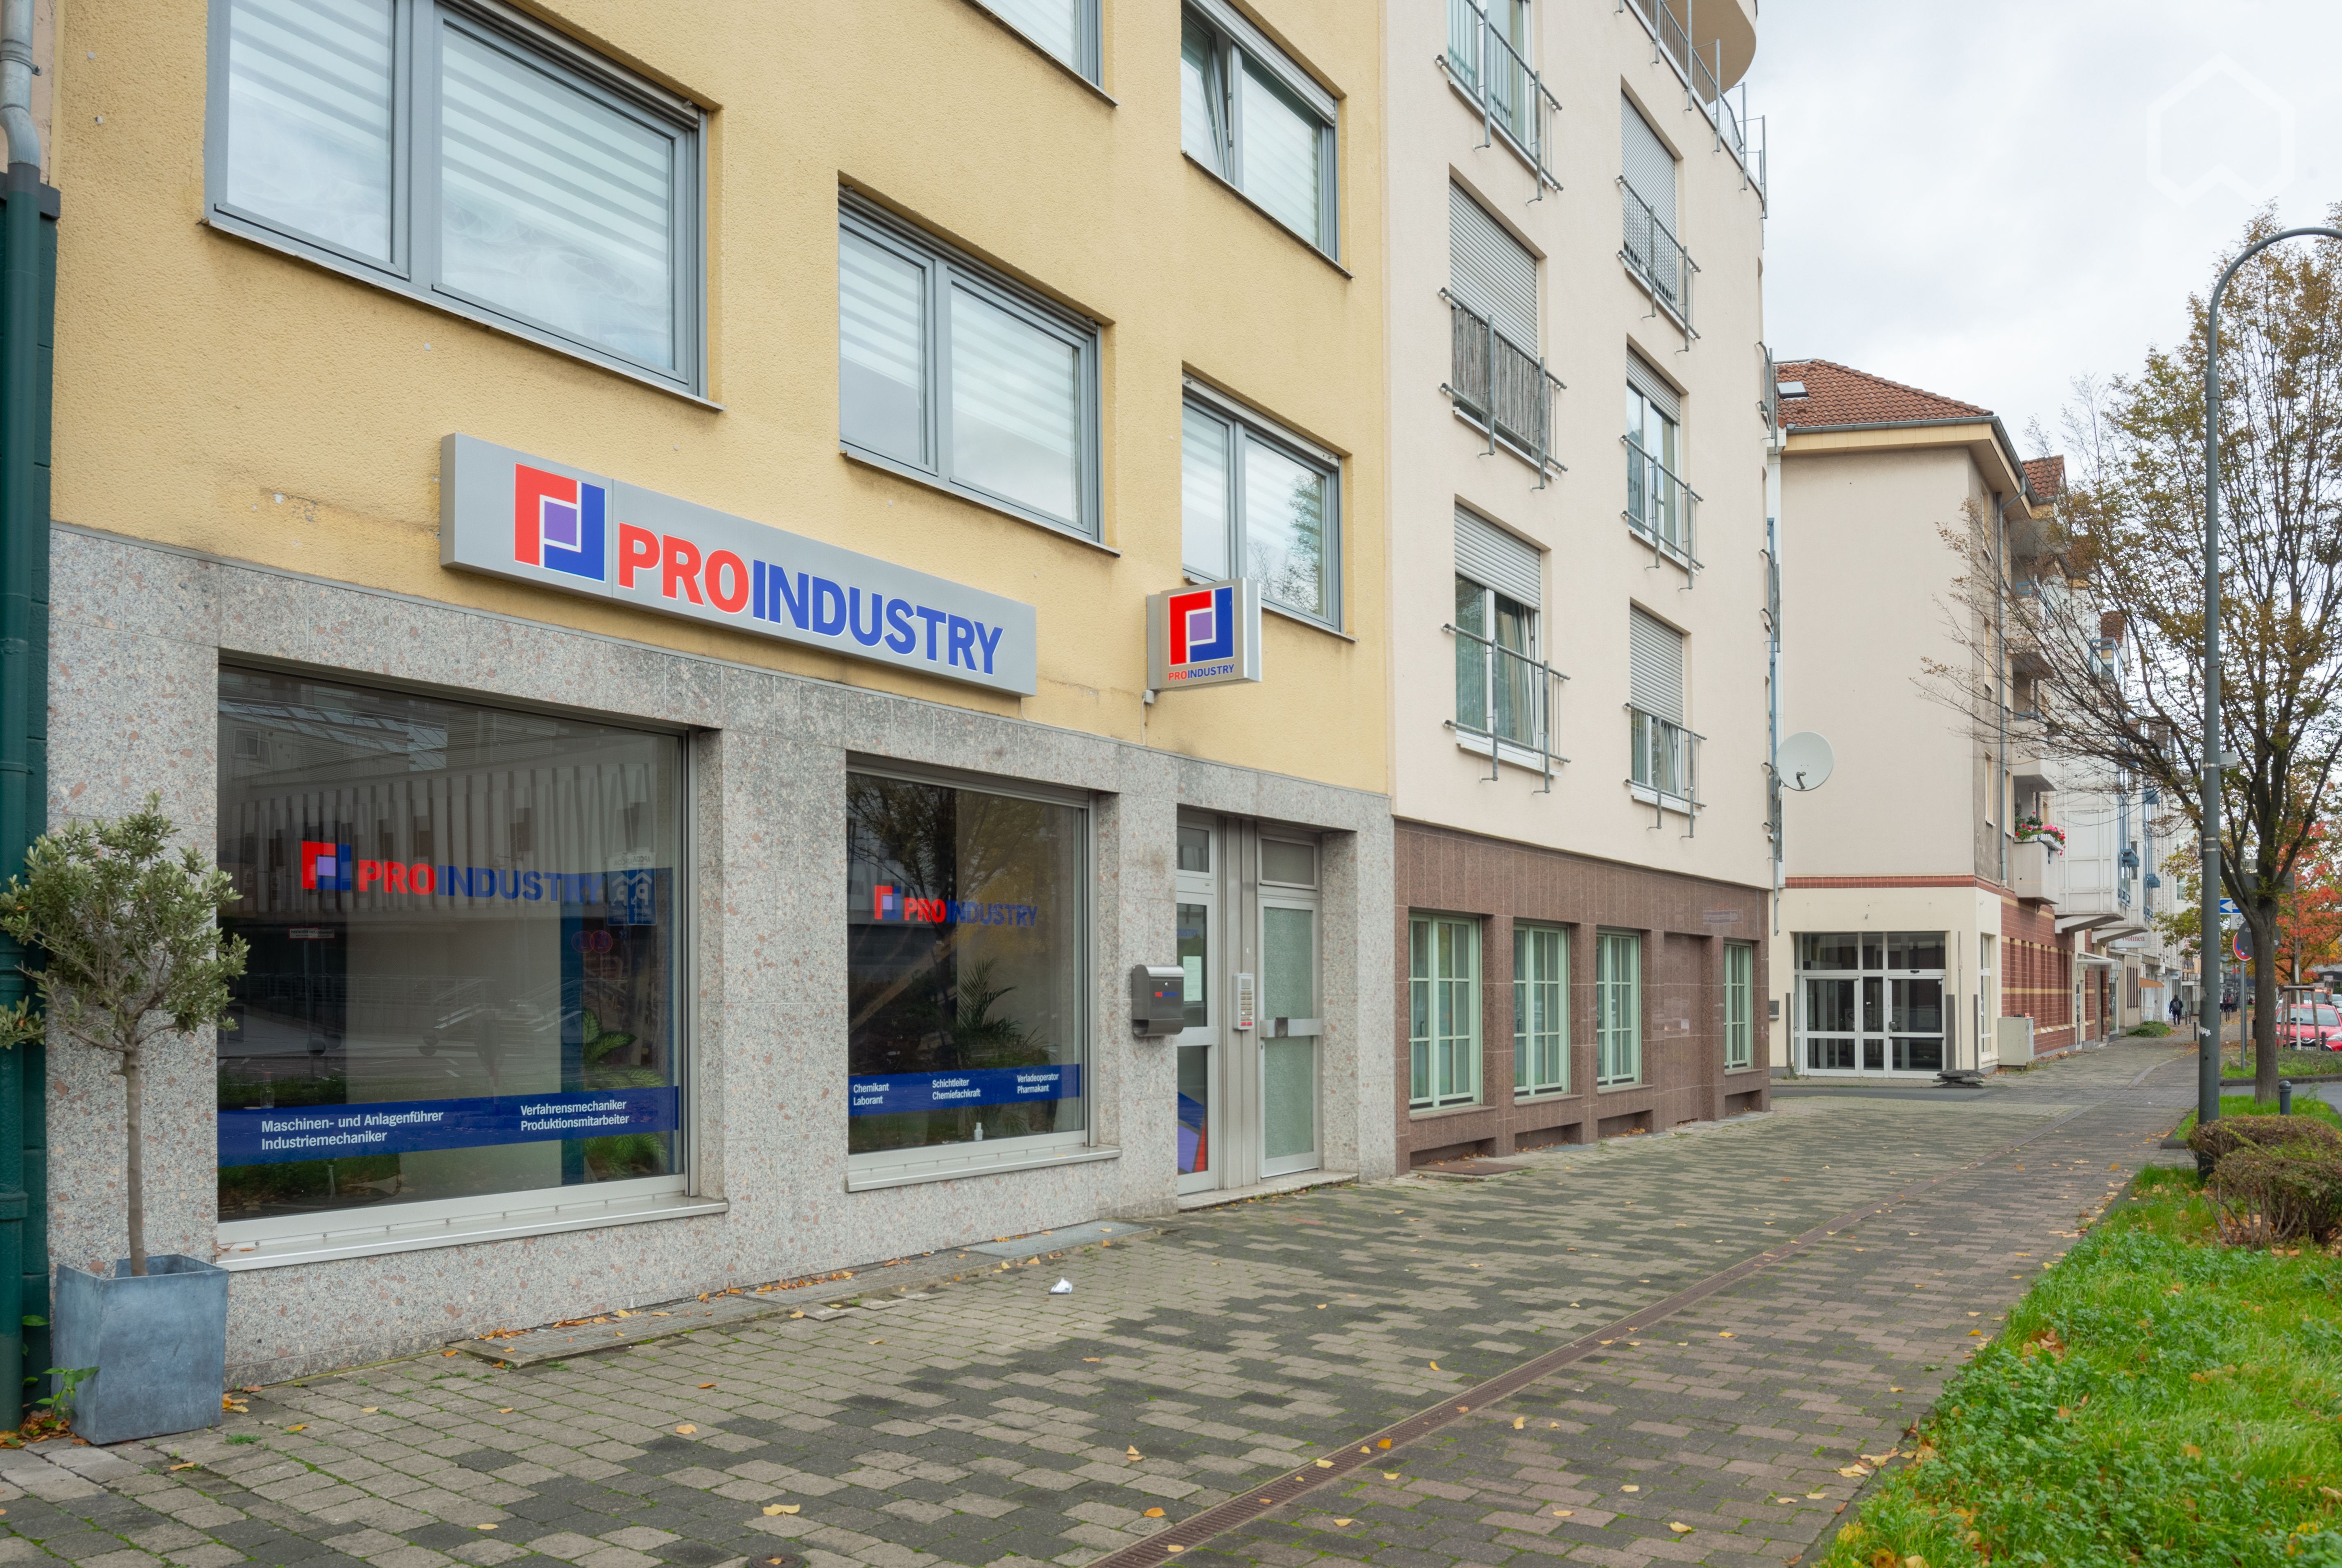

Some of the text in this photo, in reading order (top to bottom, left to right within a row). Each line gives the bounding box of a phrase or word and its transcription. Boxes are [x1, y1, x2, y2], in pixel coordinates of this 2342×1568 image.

[618, 522, 1004, 676] PROINDUSTRY
[1168, 664, 1234, 681] PROINDUSTRY
[358, 859, 603, 903] PROINDUSTRY
[904, 897, 1038, 927] PROINDUSTRY
[932, 1078, 969, 1088] Schichtleiter
[1017, 1073, 1059, 1083] Verladeoperator
[853, 1083, 889, 1093] Chemikant
[932, 1088, 981, 1100] Chemiefachkraft
[1017, 1084, 1049, 1094] Pharmakant
[520, 1100, 627, 1116] Verfahrensmechaniker
[853, 1096, 883, 1106] Laborant
[262, 1110, 444, 1132] Maschinen- und Anlagenführer
[521, 1114, 629, 1131] Produktionsmitarbeiter
[262, 1130, 387, 1150] Industriemechaniker
